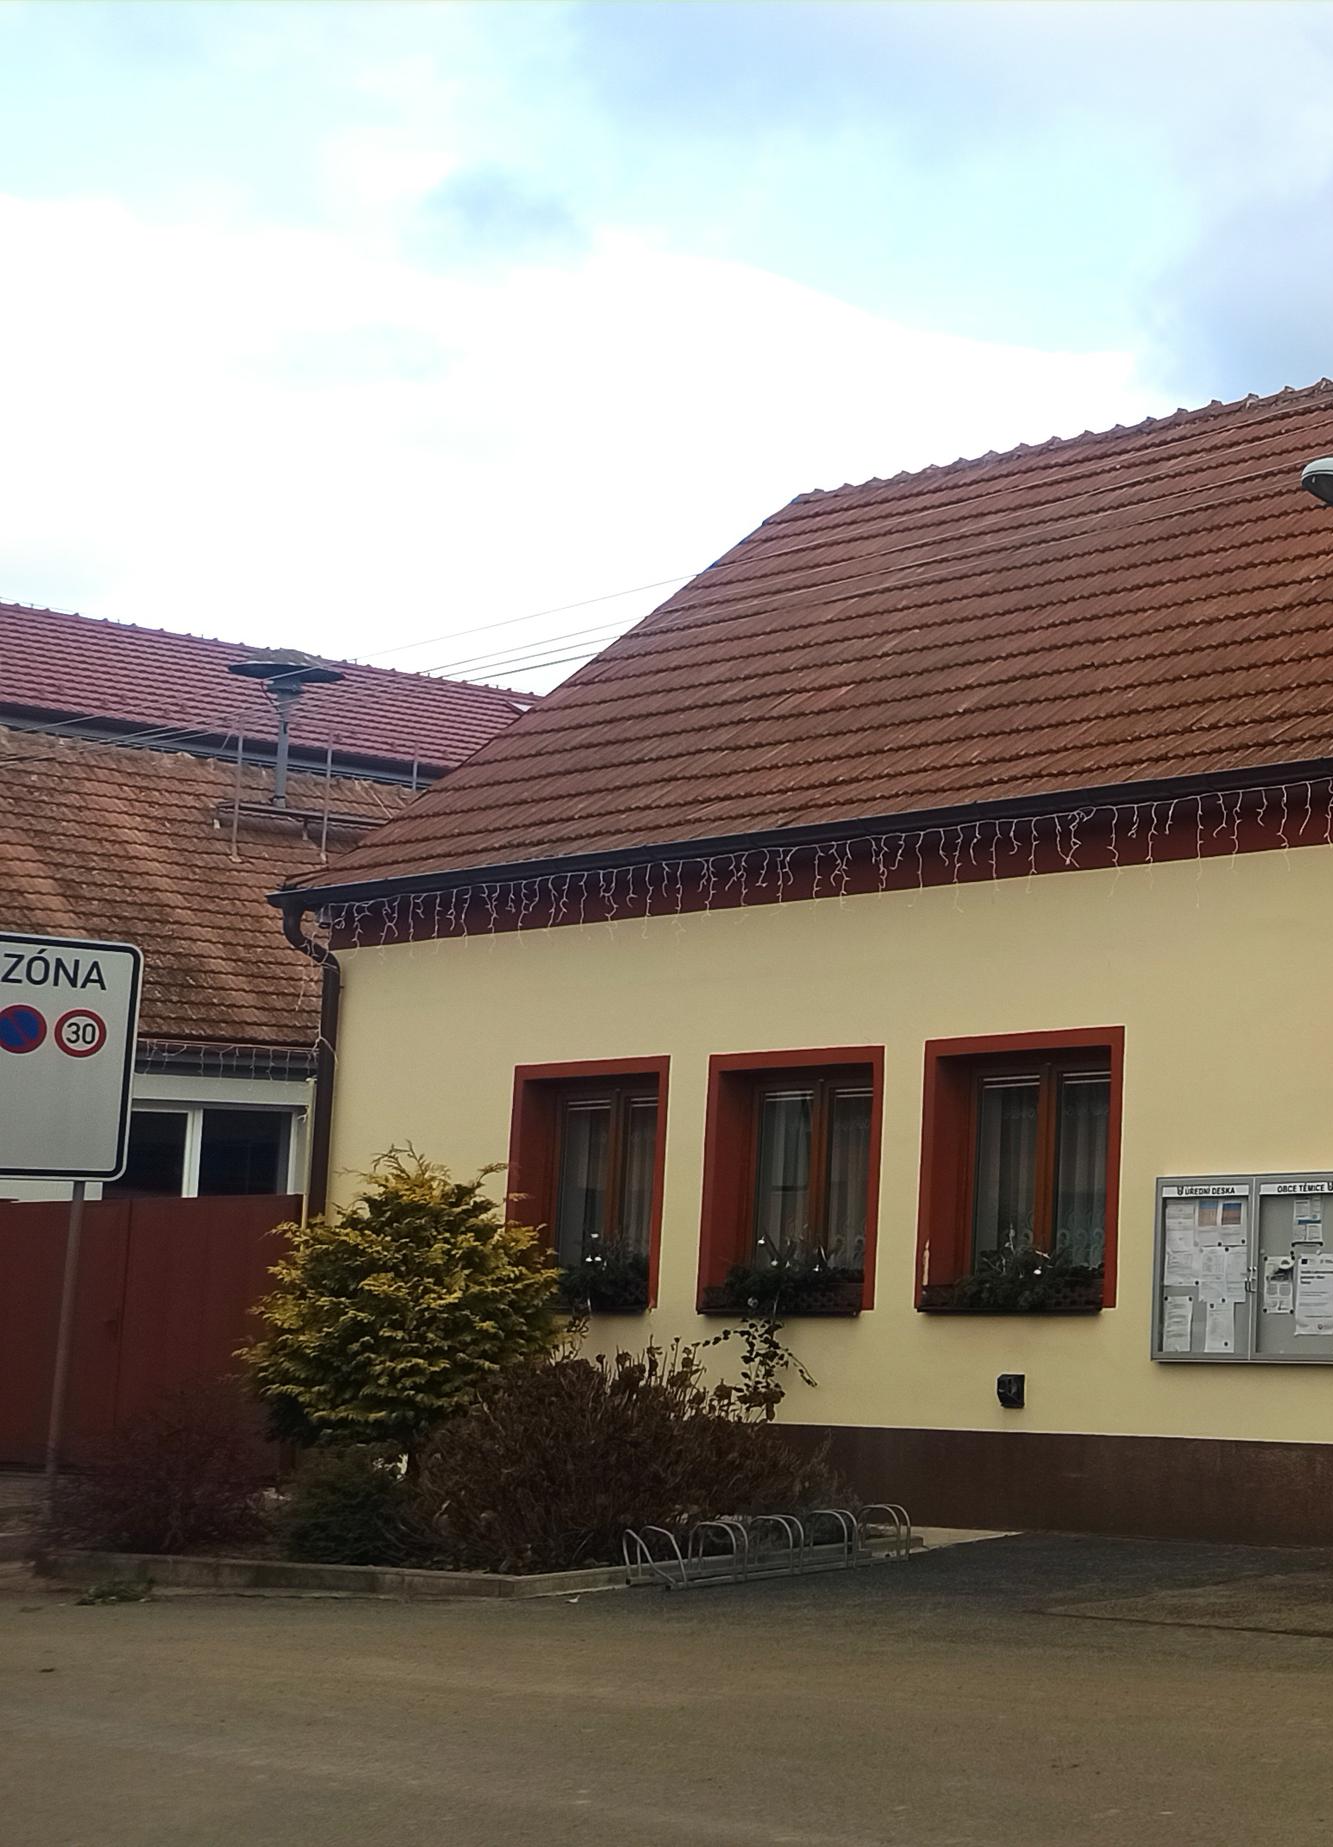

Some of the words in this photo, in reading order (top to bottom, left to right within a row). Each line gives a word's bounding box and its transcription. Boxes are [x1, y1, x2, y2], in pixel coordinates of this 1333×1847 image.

[1, 948, 107, 991] ZÓNA
[66, 1022, 97, 1045] 30
[1211, 1187, 1235, 1195] DESKA
[1277, 1184, 1297, 1193] OBCE
